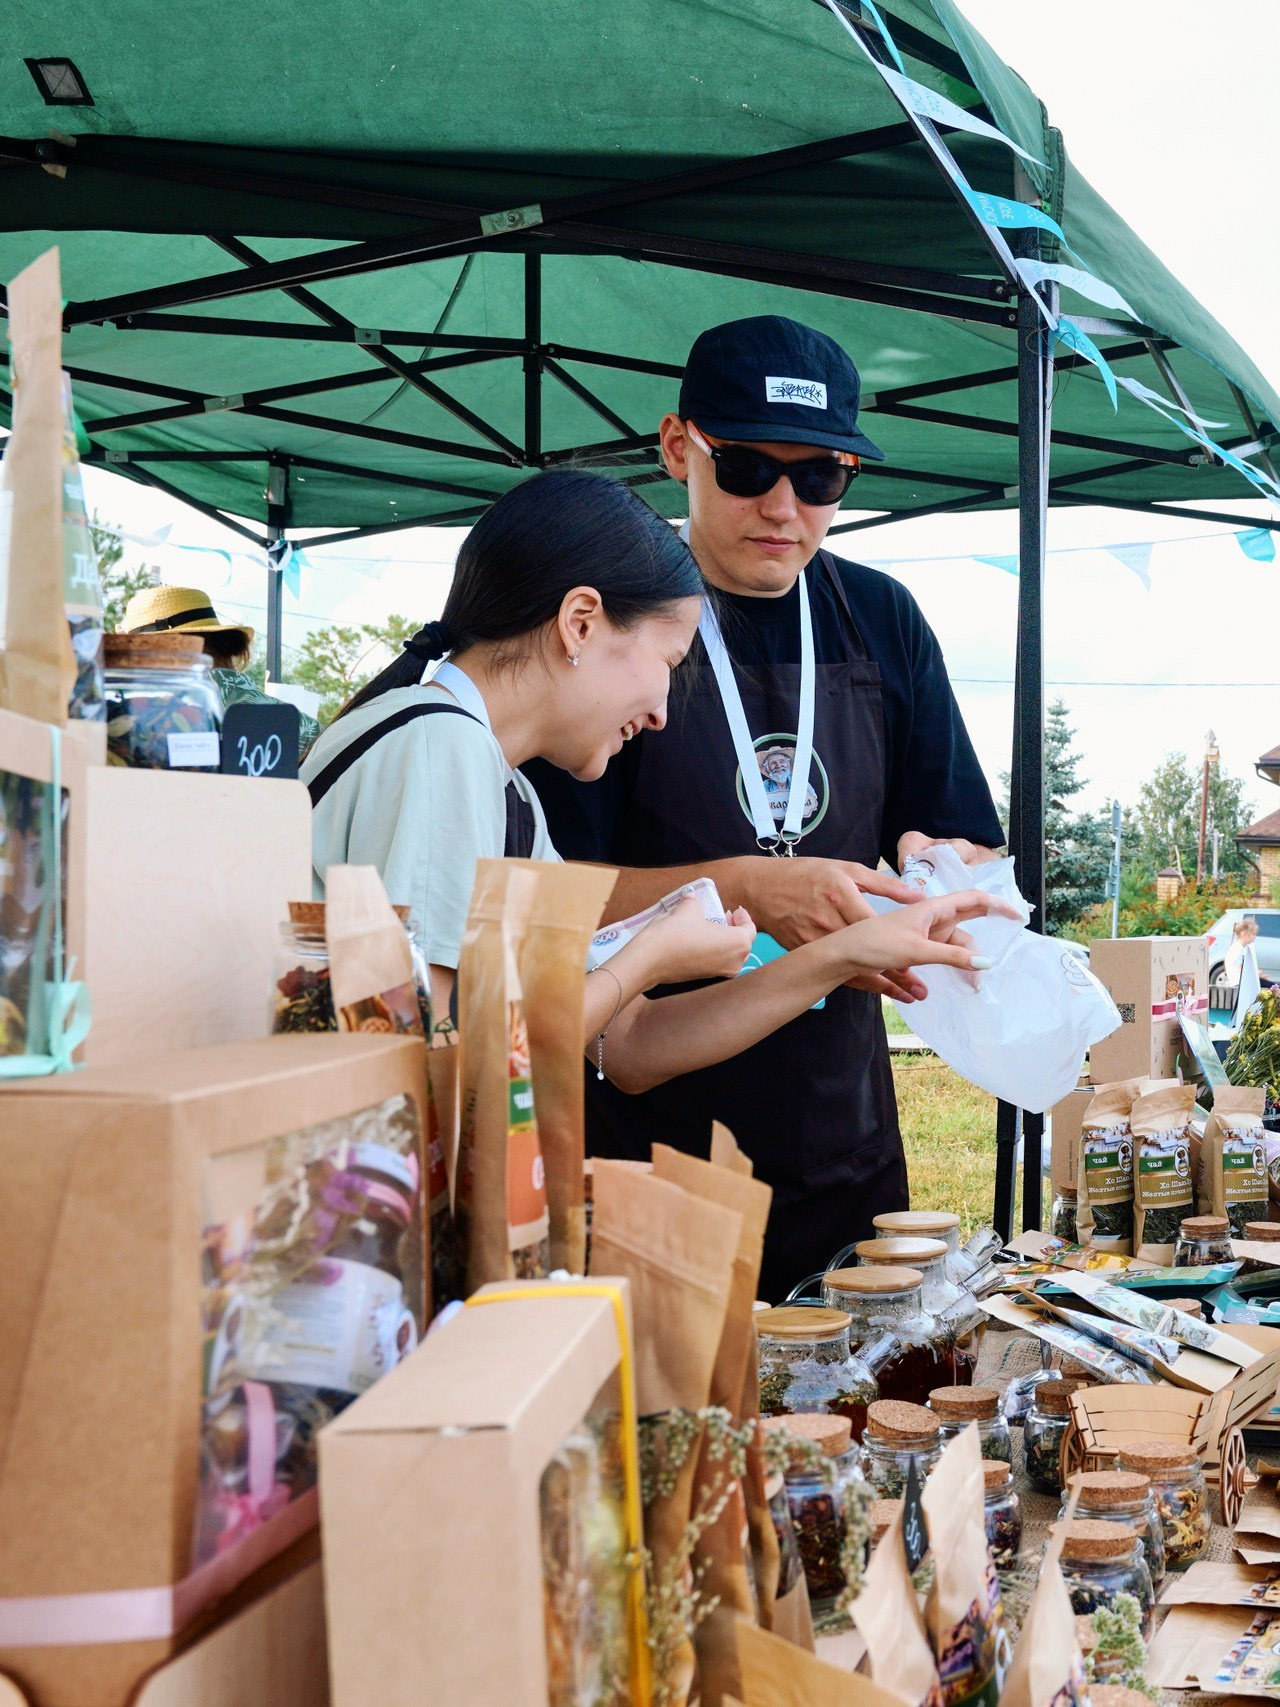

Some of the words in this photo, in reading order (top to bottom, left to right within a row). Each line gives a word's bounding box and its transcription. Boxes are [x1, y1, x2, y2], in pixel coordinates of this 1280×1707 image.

[237, 733, 282, 777] 300
[1092, 1156, 1108, 1164] чай
[1231, 1157, 1246, 1165] чай
[1142, 1190, 1170, 1198] Желтые
